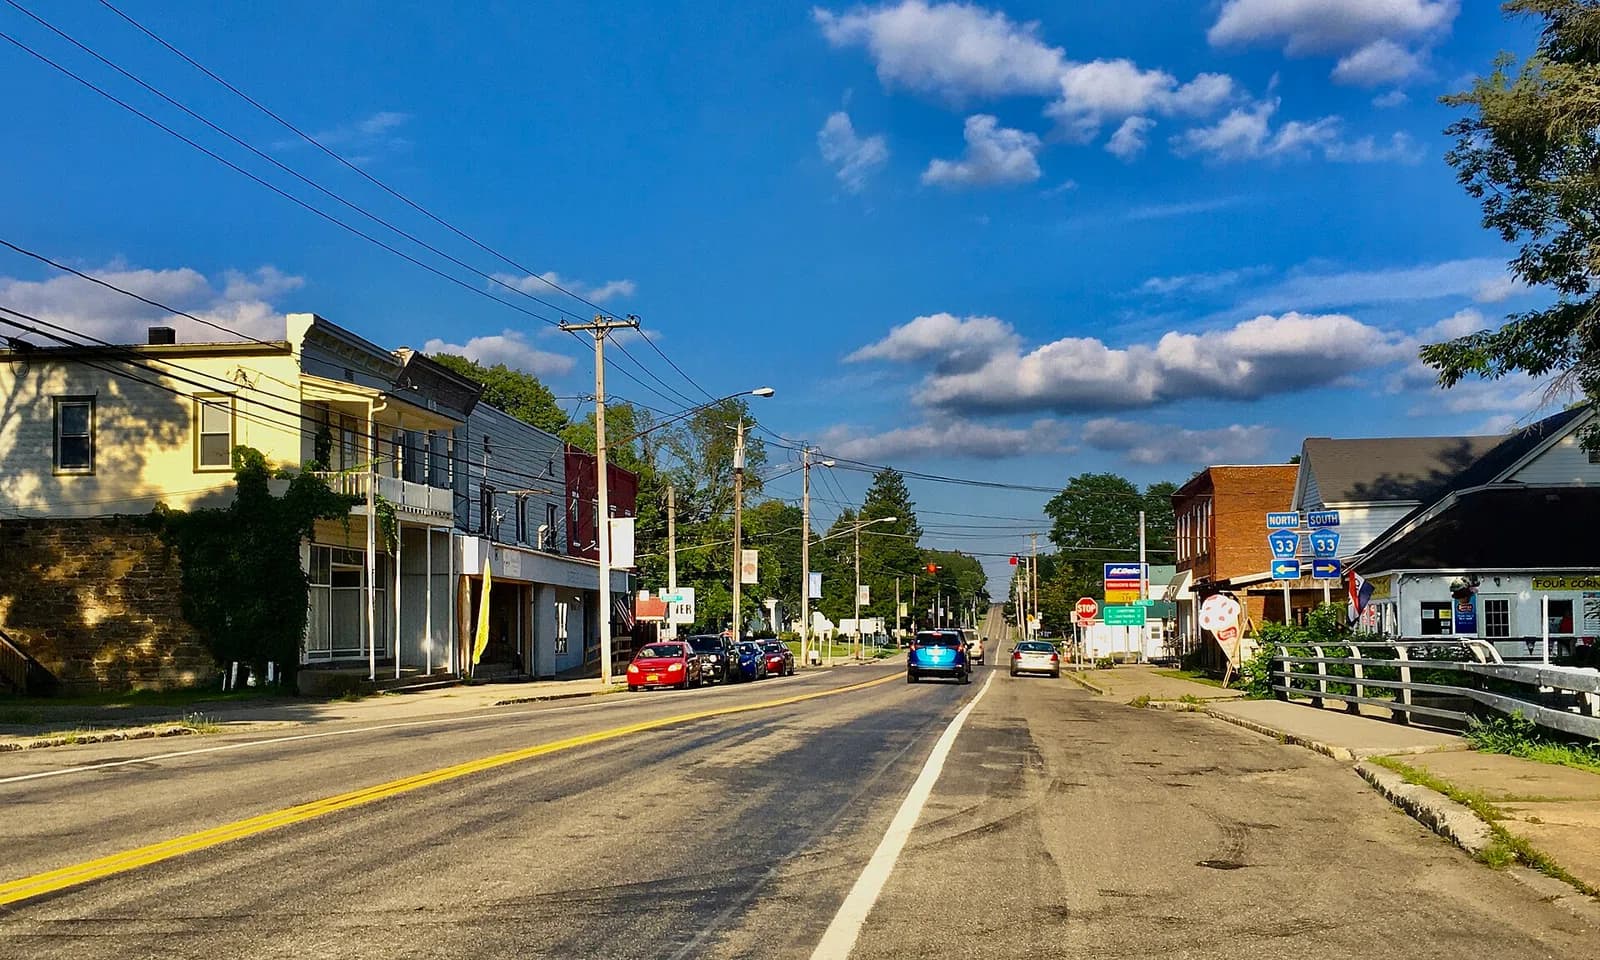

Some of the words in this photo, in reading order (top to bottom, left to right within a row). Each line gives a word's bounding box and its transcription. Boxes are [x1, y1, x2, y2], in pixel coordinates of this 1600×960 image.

[1269, 515, 1297, 525] NORTH
[1310, 514, 1338, 525] SOUTH
[1276, 540, 1294, 553] 33
[1317, 539, 1335, 552] 33
[1536, 580, 1566, 588] FOUR
[1077, 604, 1096, 613] STOP
